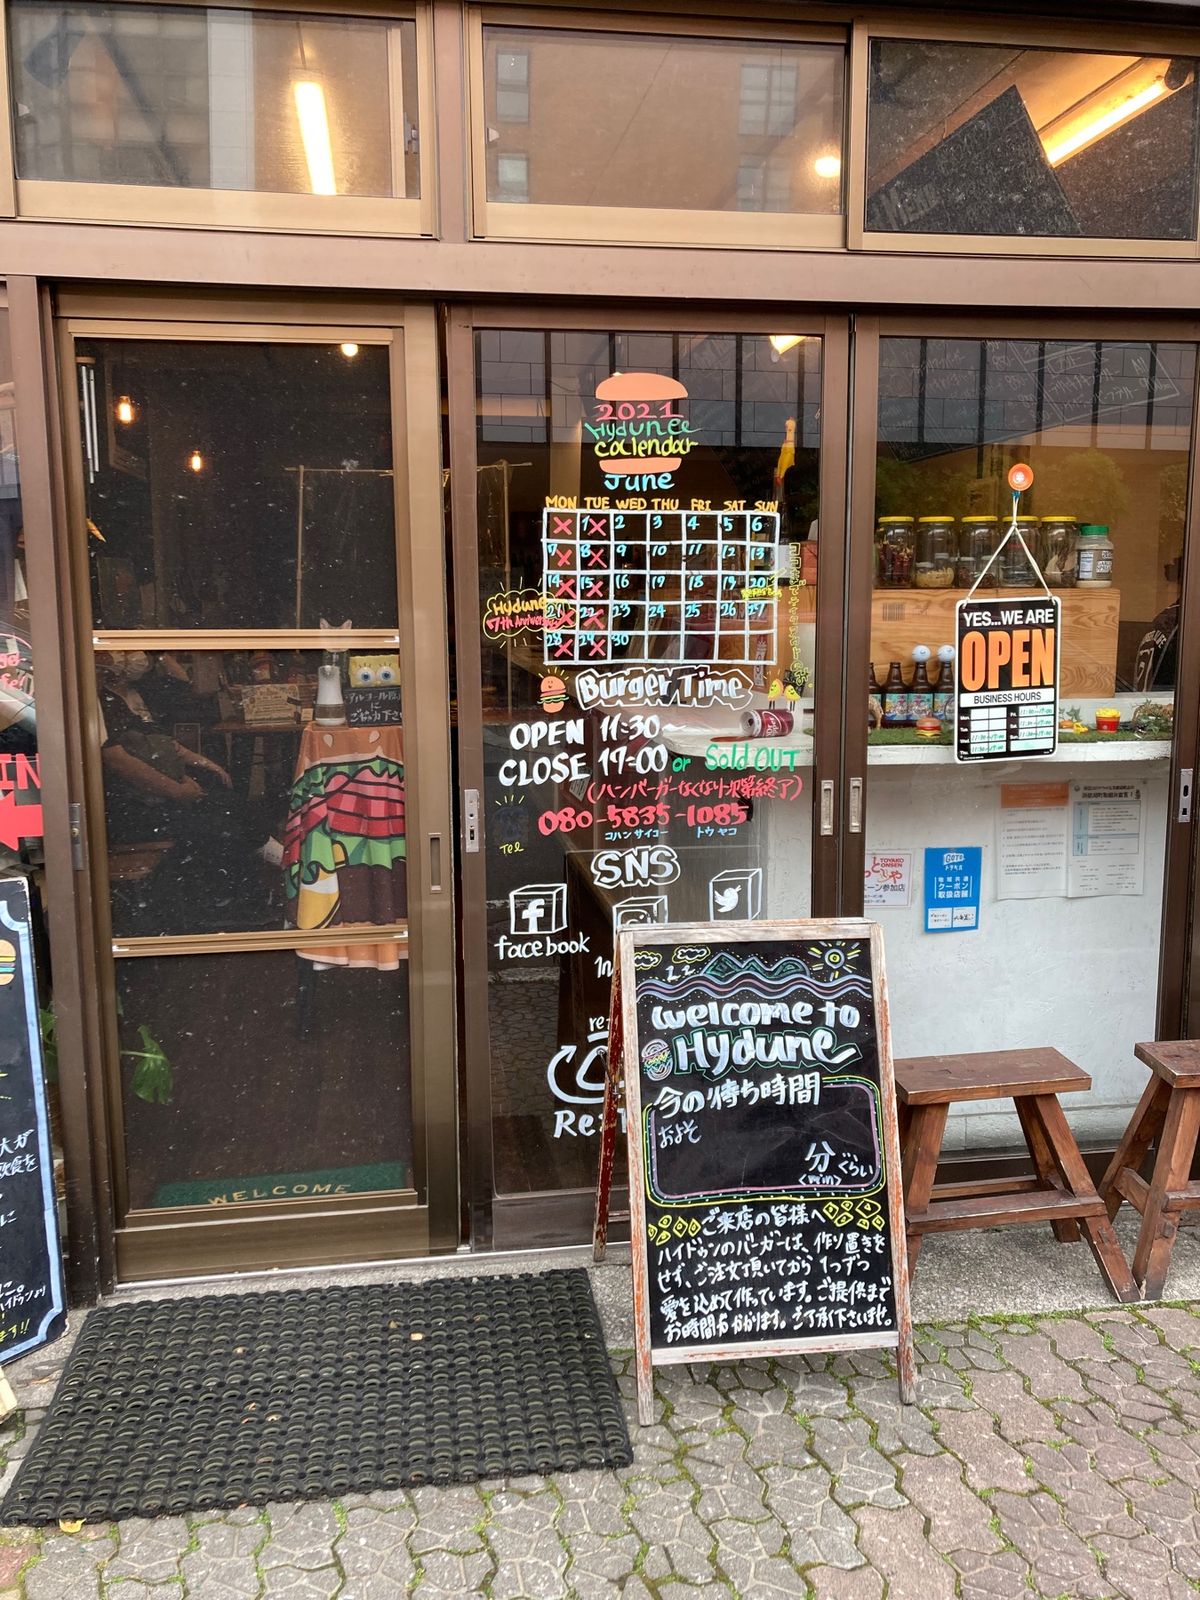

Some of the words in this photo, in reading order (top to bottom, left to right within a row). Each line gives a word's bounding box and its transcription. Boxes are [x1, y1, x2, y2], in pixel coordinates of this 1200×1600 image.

[593, 402, 684, 422] 2021
[604, 472, 675, 492] June
[546, 495, 576, 509] MON
[584, 496, 610, 509] TUE
[616, 498, 647, 510] WED
[651, 499, 679, 510] THU
[691, 499, 711, 510] FRI
[723, 500, 746, 511] SAT
[754, 500, 778, 512] SUN
[582, 515, 590, 531] 1
[615, 516, 625, 529] 2
[653, 515, 662, 528] 3
[688, 516, 699, 530] 4
[723, 517, 733, 531] 5
[752, 516, 762, 531] 6
[581, 544, 591, 556] 8
[617, 544, 626, 556] 9
[652, 545, 667, 556] 10
[689, 544, 703, 555] 11
[722, 546, 735, 558] 12
[751, 546, 765, 558] 13
[547, 576, 562, 587] 14
[581, 576, 594, 588] 15
[615, 575, 629, 587] 16
[689, 576, 703, 590] 18
[723, 576, 736, 590] 19
[750, 576, 766, 588] 20
[546, 604, 562, 617] 21
[612, 604, 630, 617] 23
[649, 605, 666, 618] 24
[685, 604, 702, 617] 25
[721, 603, 736, 616] 26
[1025, 608, 1054, 624] ARE
[546, 634, 562, 646] 28
[612, 634, 629, 645] 30
[961, 628, 1055, 691] OPEN
[577, 674, 673, 702] Burger
[677, 671, 745, 704] Time
[974, 693, 1012, 704] BUSINESS
[1014, 691, 1042, 702] HOURS
[509, 719, 584, 750] OPEN
[499, 752, 590, 786] CLOSE
[598, 744, 668, 776] 17:00
[672, 757, 692, 773] or
[705, 742, 749, 772] Sold
[754, 749, 800, 772] OUT
[596, 850, 675, 883] SNS
[494, 932, 590, 960] facebook
[817, 1001, 860, 1028] to
[676, 1028, 857, 1077] Hydune
[654, 1071, 820, 1119] 今の待ち時間
[658, 1119, 702, 1149] およそ
[805, 1141, 836, 1172] 分
[208, 1184, 351, 1205] WELCOME
[702, 1203, 826, 1236] ご来店の皆様へ
